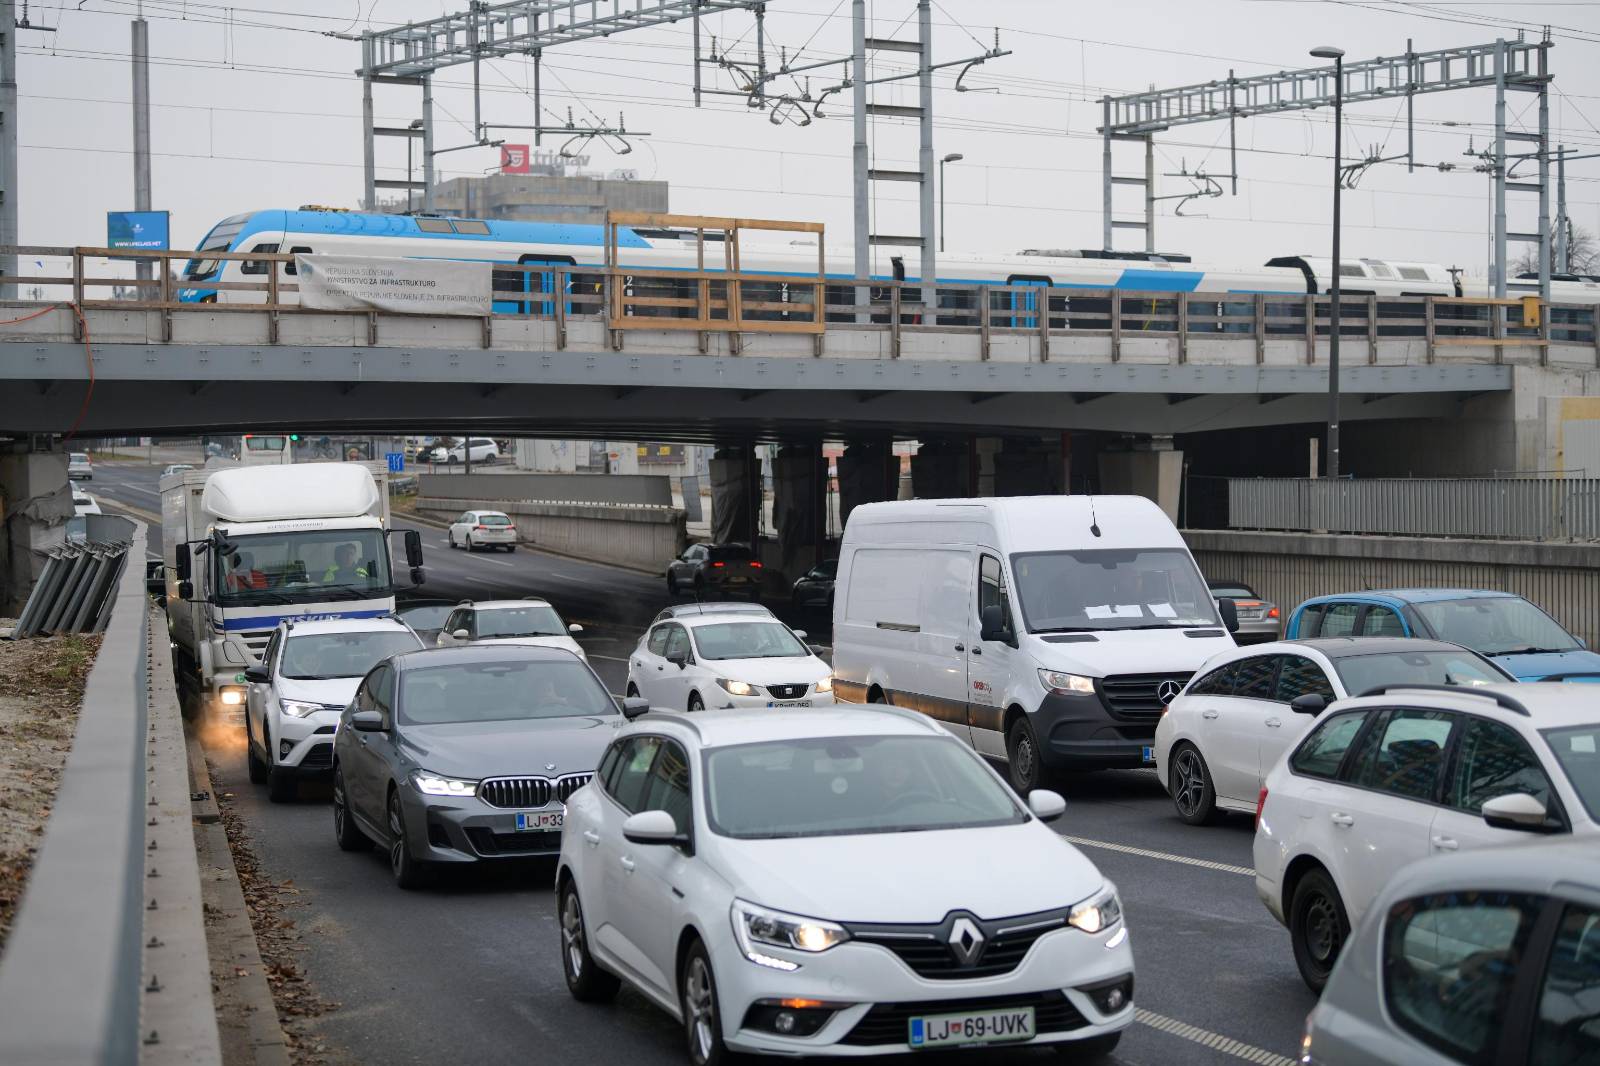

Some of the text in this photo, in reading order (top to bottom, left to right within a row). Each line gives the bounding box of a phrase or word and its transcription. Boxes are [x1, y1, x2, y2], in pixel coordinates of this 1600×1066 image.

[533, 149, 590, 169] triglav
[362, 268, 394, 277] SLOVENIJA
[368, 278, 378, 286] ZA
[379, 278, 436, 287] INFRASTRUKTURO
[627, 275, 633, 286] 2
[426, 293, 435, 301] ZA
[436, 294, 489, 303] INFRASTRUKTURO
[526, 815, 541, 828] LJ
[926, 1013, 1028, 1041] LJ 69-UVK
